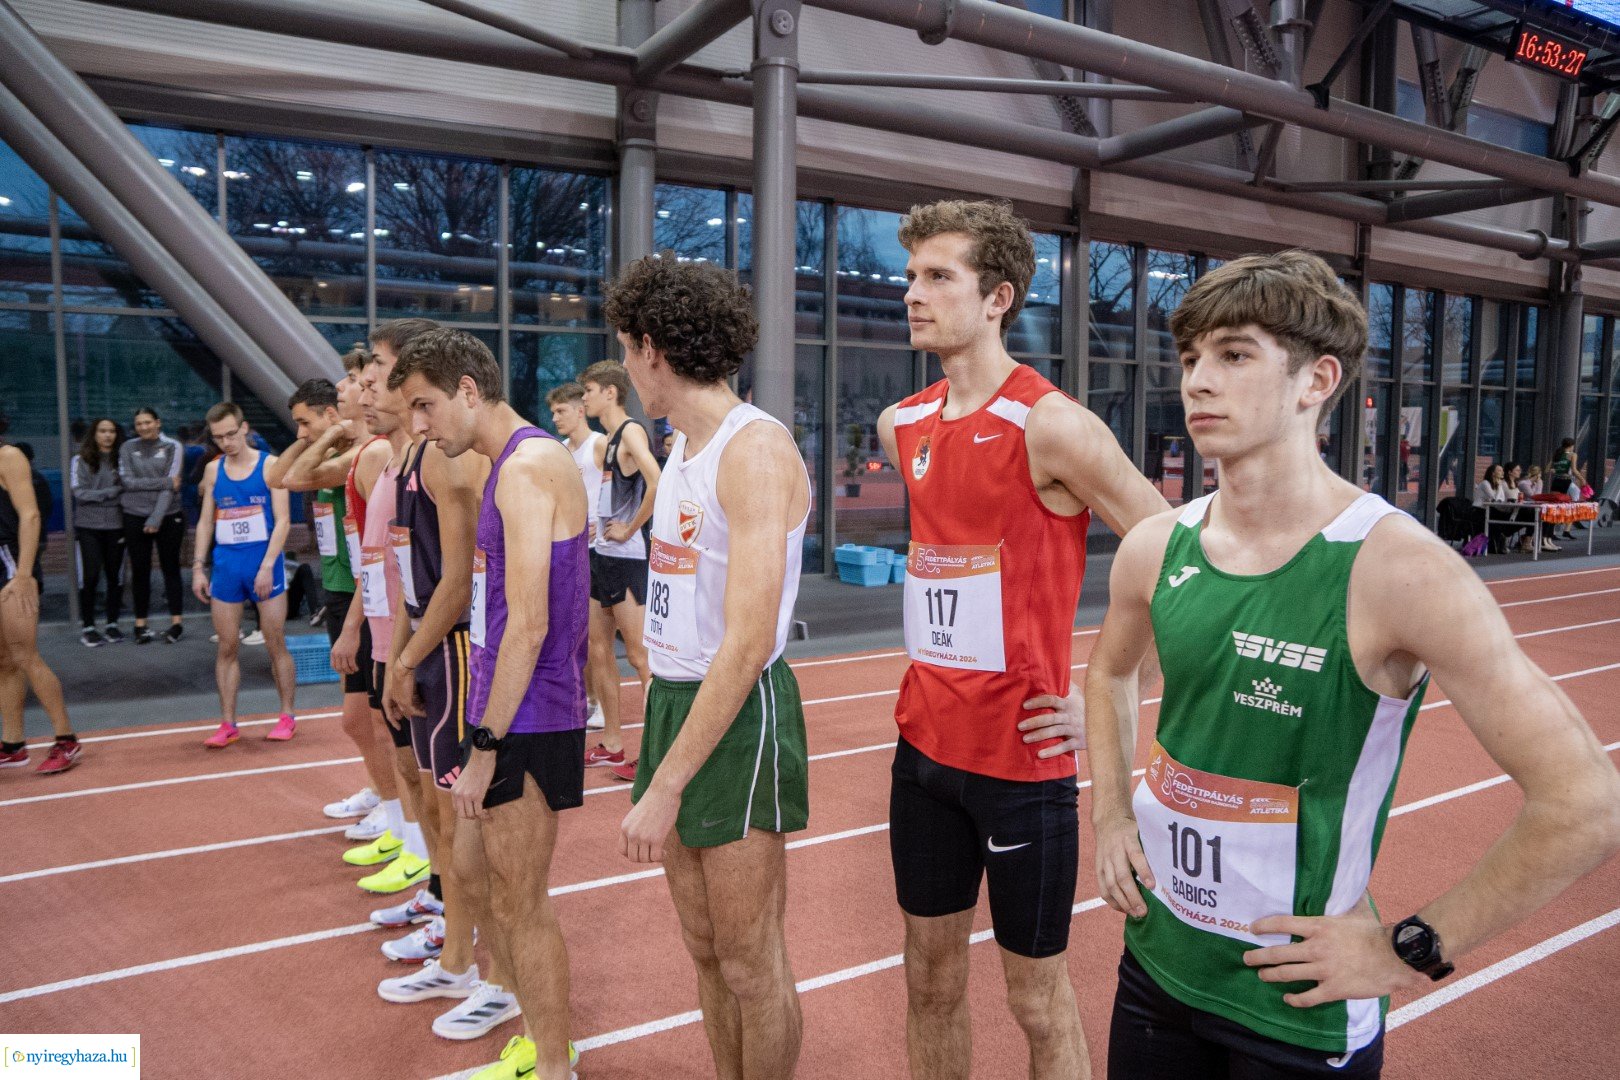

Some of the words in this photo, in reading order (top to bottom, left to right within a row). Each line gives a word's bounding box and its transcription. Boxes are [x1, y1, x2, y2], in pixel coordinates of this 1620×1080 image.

[1517, 32, 1586, 76] 16:53:27
[231, 521, 250, 535] 138
[650, 578, 670, 619] 183
[925, 587, 959, 627] 117
[650, 617, 663, 636] TÓTH
[931, 630, 953, 648] DEÁK
[959, 653, 978, 663] 2024
[1232, 630, 1328, 673] SVSE
[1233, 690, 1302, 718] VESZPRÉM
[1172, 779, 1244, 806] FEDETTPÁLYÁS
[1168, 821, 1222, 884] 101
[1172, 875, 1218, 909] BABICS
[1220, 918, 1250, 933] 2024
